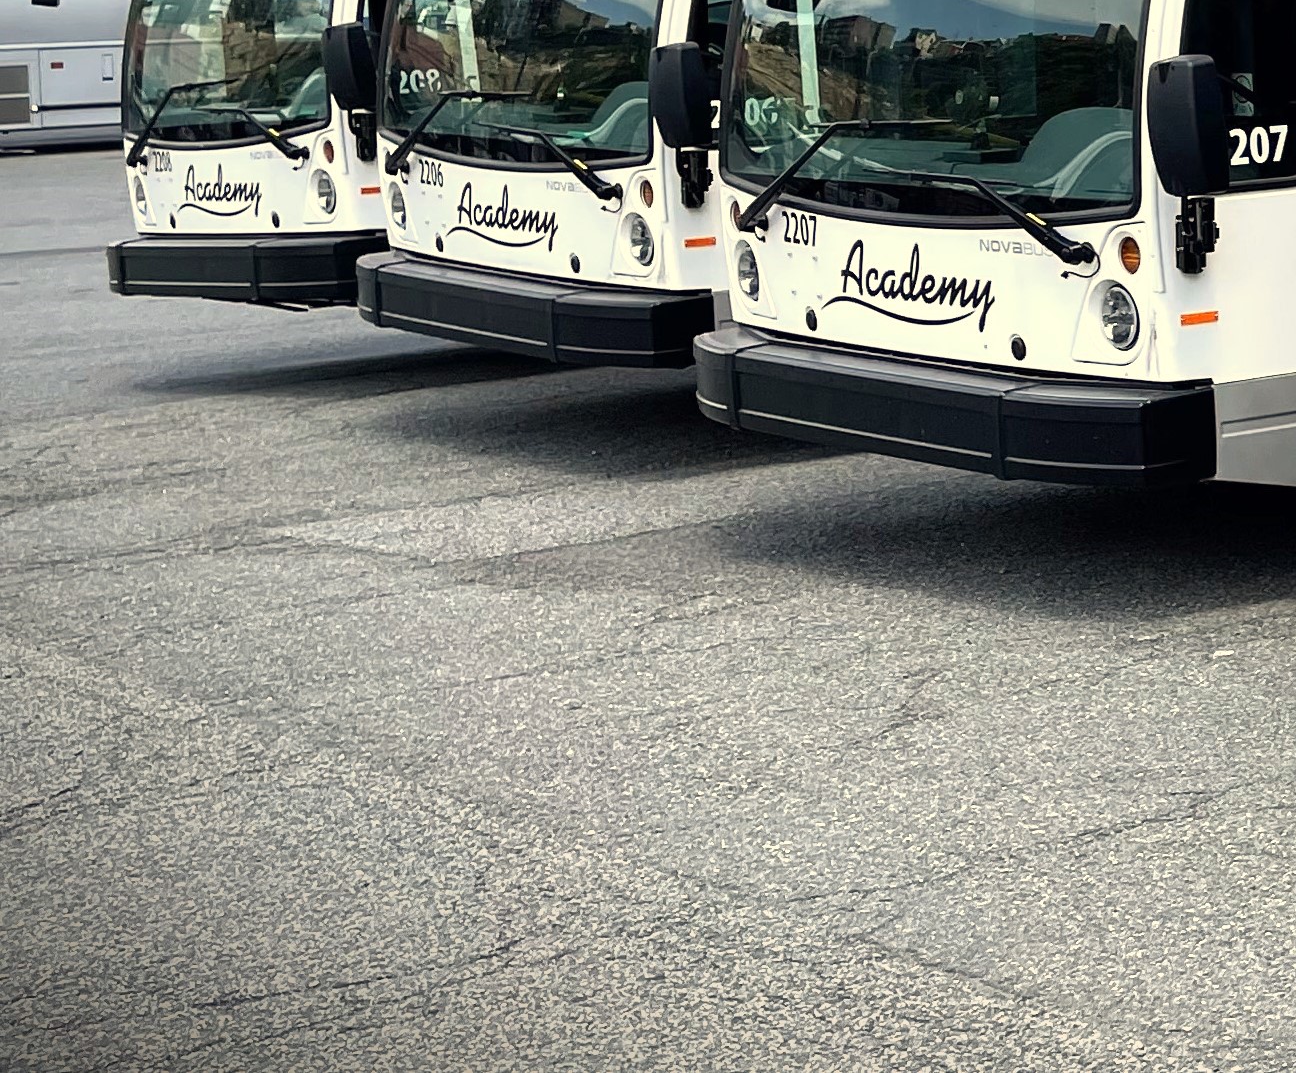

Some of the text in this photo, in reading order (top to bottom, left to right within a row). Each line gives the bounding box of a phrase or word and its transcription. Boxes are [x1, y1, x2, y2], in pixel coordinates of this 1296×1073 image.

[184, 163, 262, 218] Academy
[419, 158, 444, 188] 2206
[457, 181, 558, 252] Academy
[781, 210, 817, 247] 2207
[840, 239, 996, 333] Academy
